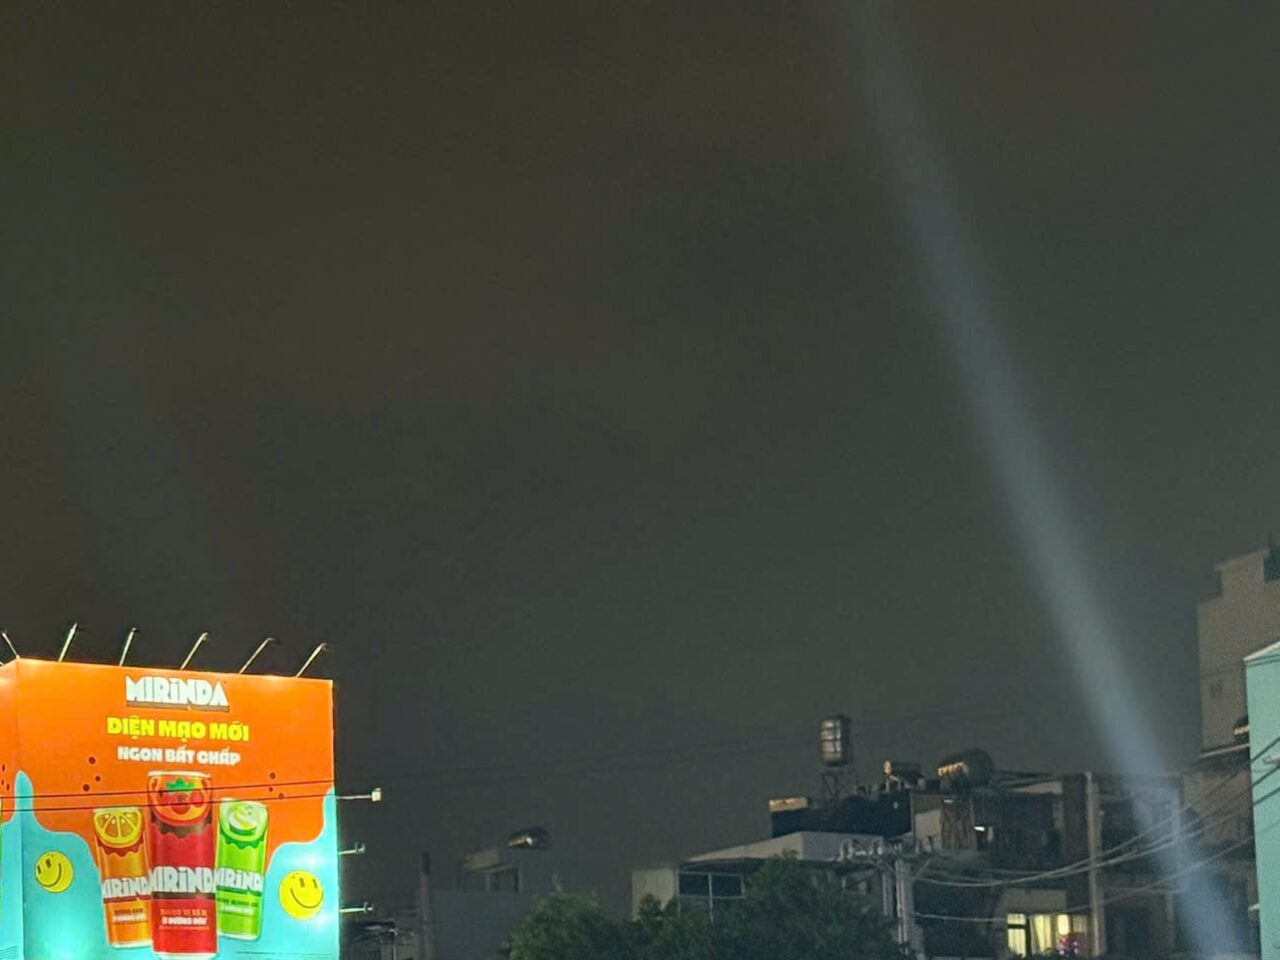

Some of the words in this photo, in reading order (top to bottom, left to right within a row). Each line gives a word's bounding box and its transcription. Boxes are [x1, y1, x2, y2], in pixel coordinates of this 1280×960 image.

[107, 715, 155, 740] DIỆN
[158, 720, 206, 742] MẠO
[209, 720, 250, 742] MỚI
[117, 746, 163, 761] NGON
[165, 745, 195, 764] BẤT
[197, 746, 241, 765] CHẤP
